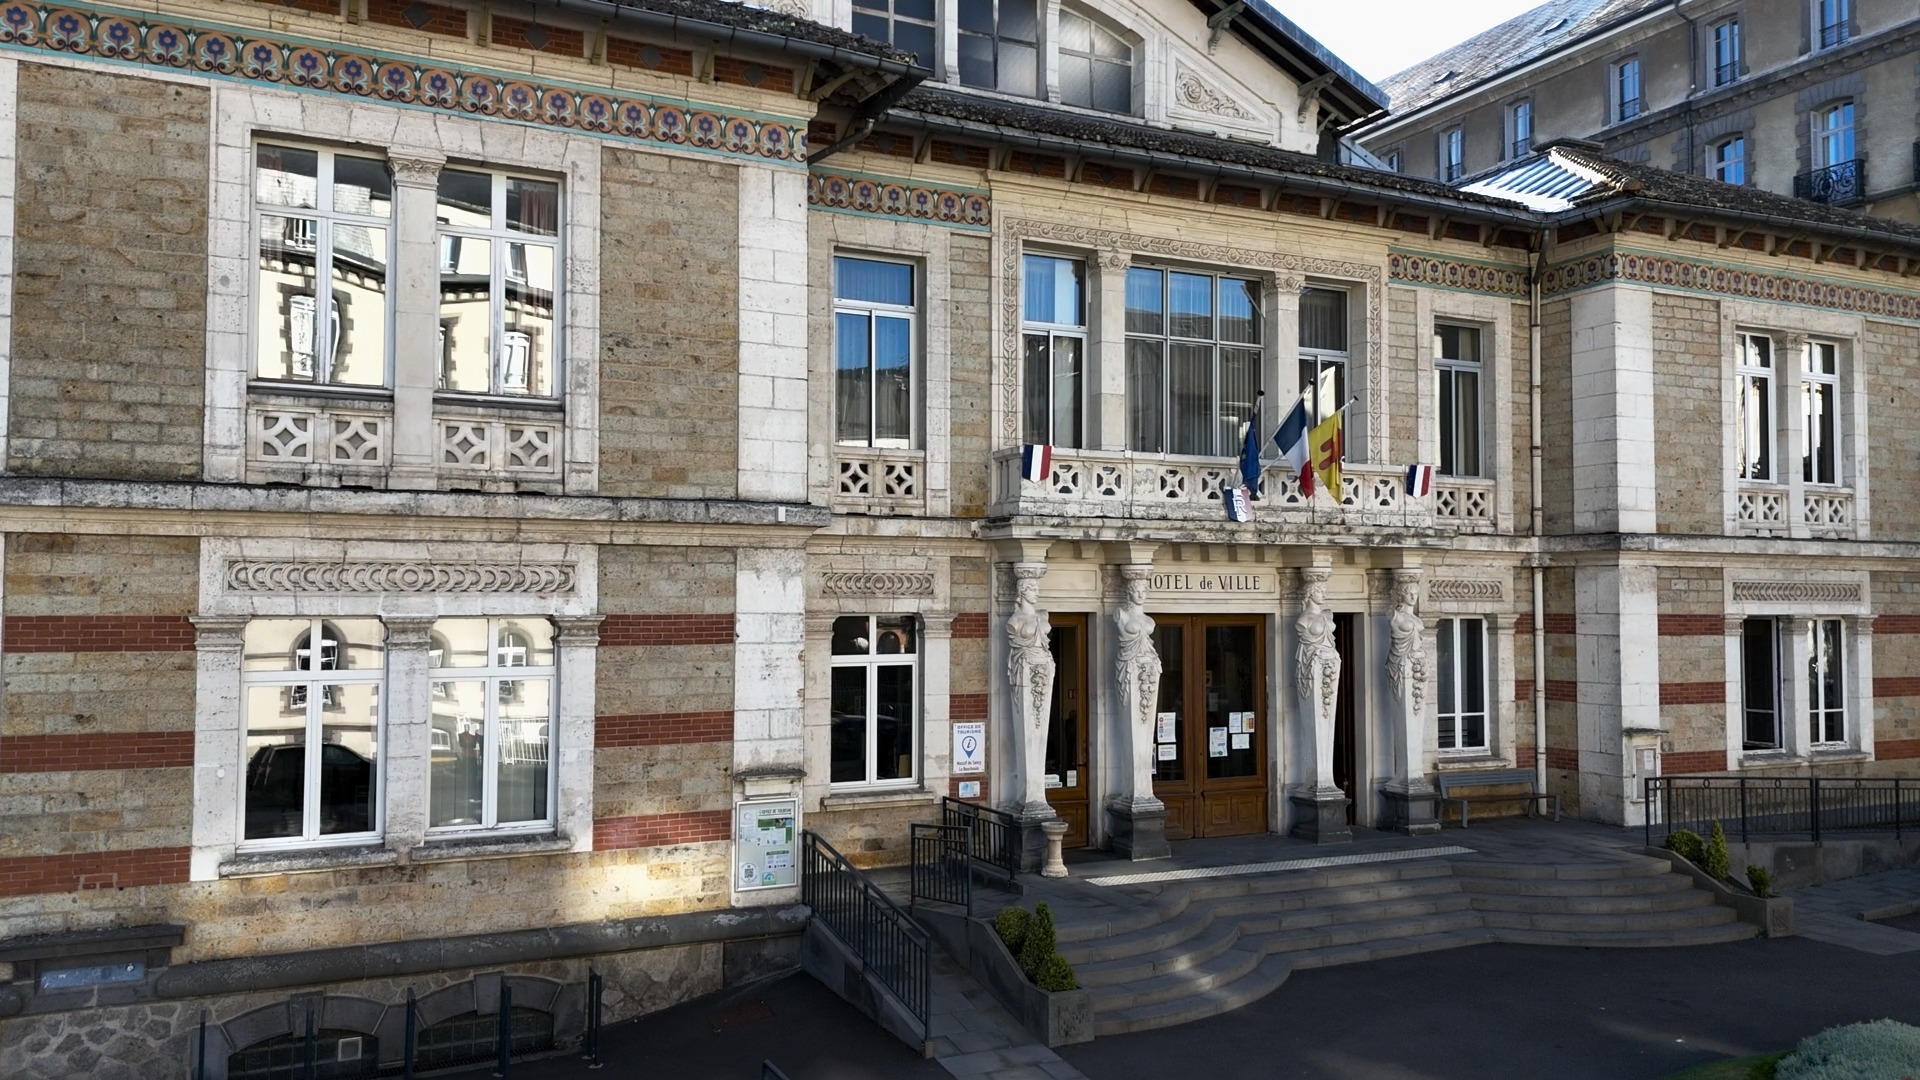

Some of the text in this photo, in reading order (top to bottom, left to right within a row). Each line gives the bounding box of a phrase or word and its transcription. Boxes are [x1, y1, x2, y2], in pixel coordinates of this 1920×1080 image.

[1149, 574, 1260, 590] OTEL de VILLE
